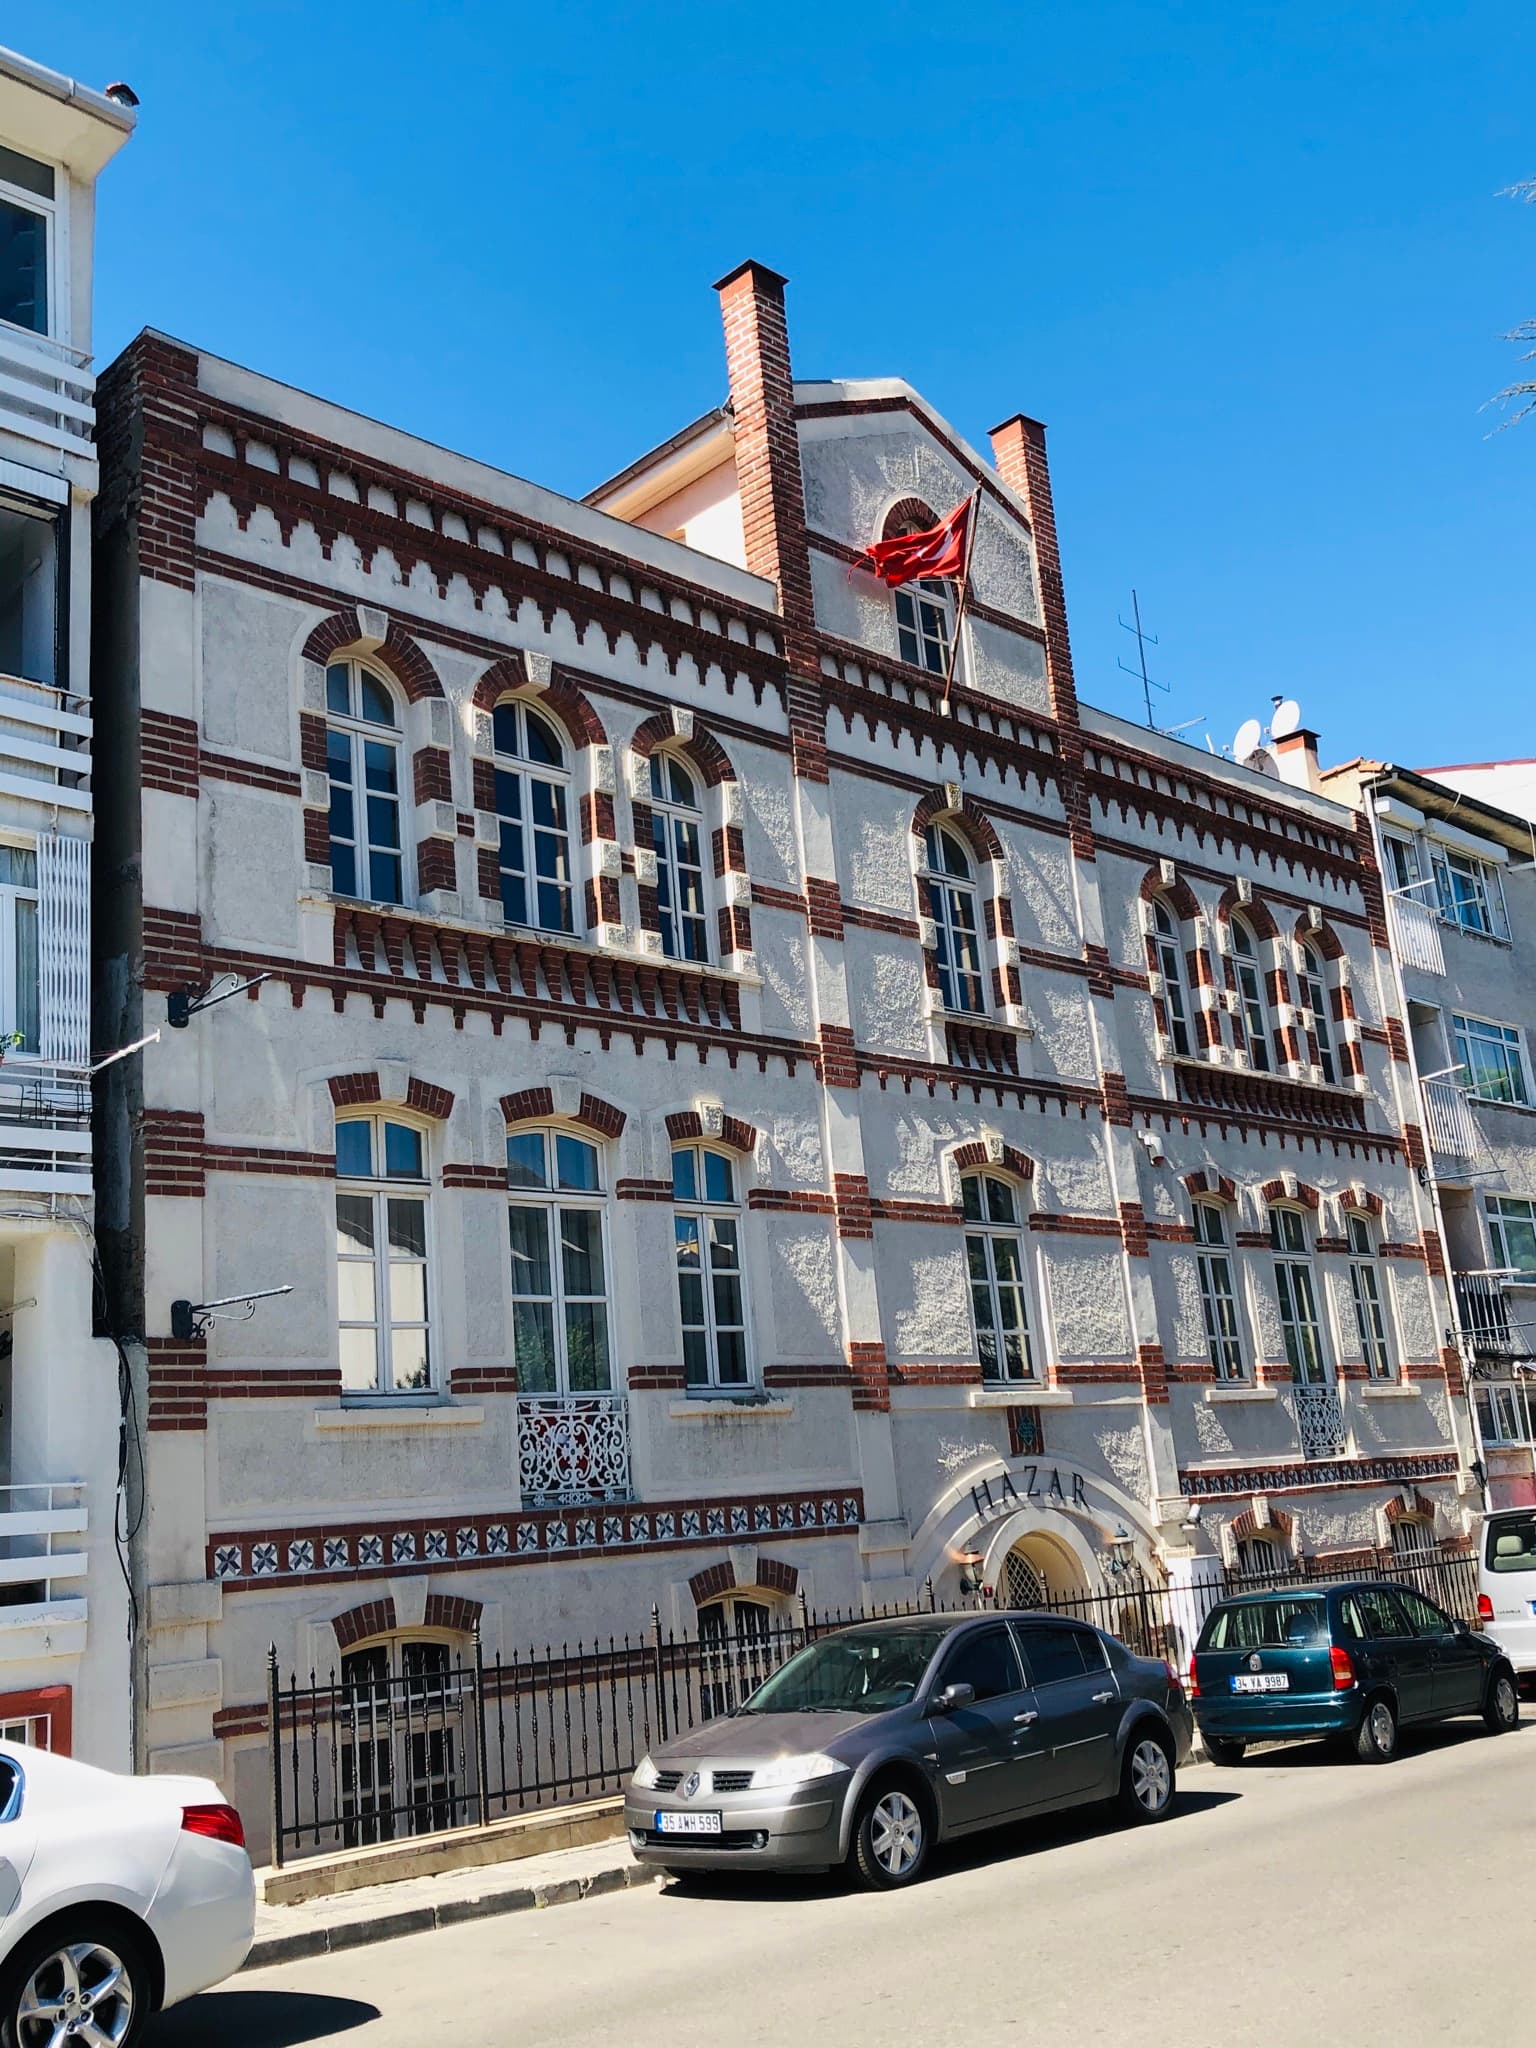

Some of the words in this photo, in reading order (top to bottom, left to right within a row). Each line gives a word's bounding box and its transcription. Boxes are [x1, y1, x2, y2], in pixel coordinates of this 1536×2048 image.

[971, 1465, 1093, 1516] HAZAR
[1237, 1678, 1247, 1689] 34
[663, 1815, 675, 1831] 35
[699, 1815, 719, 1831] 599
